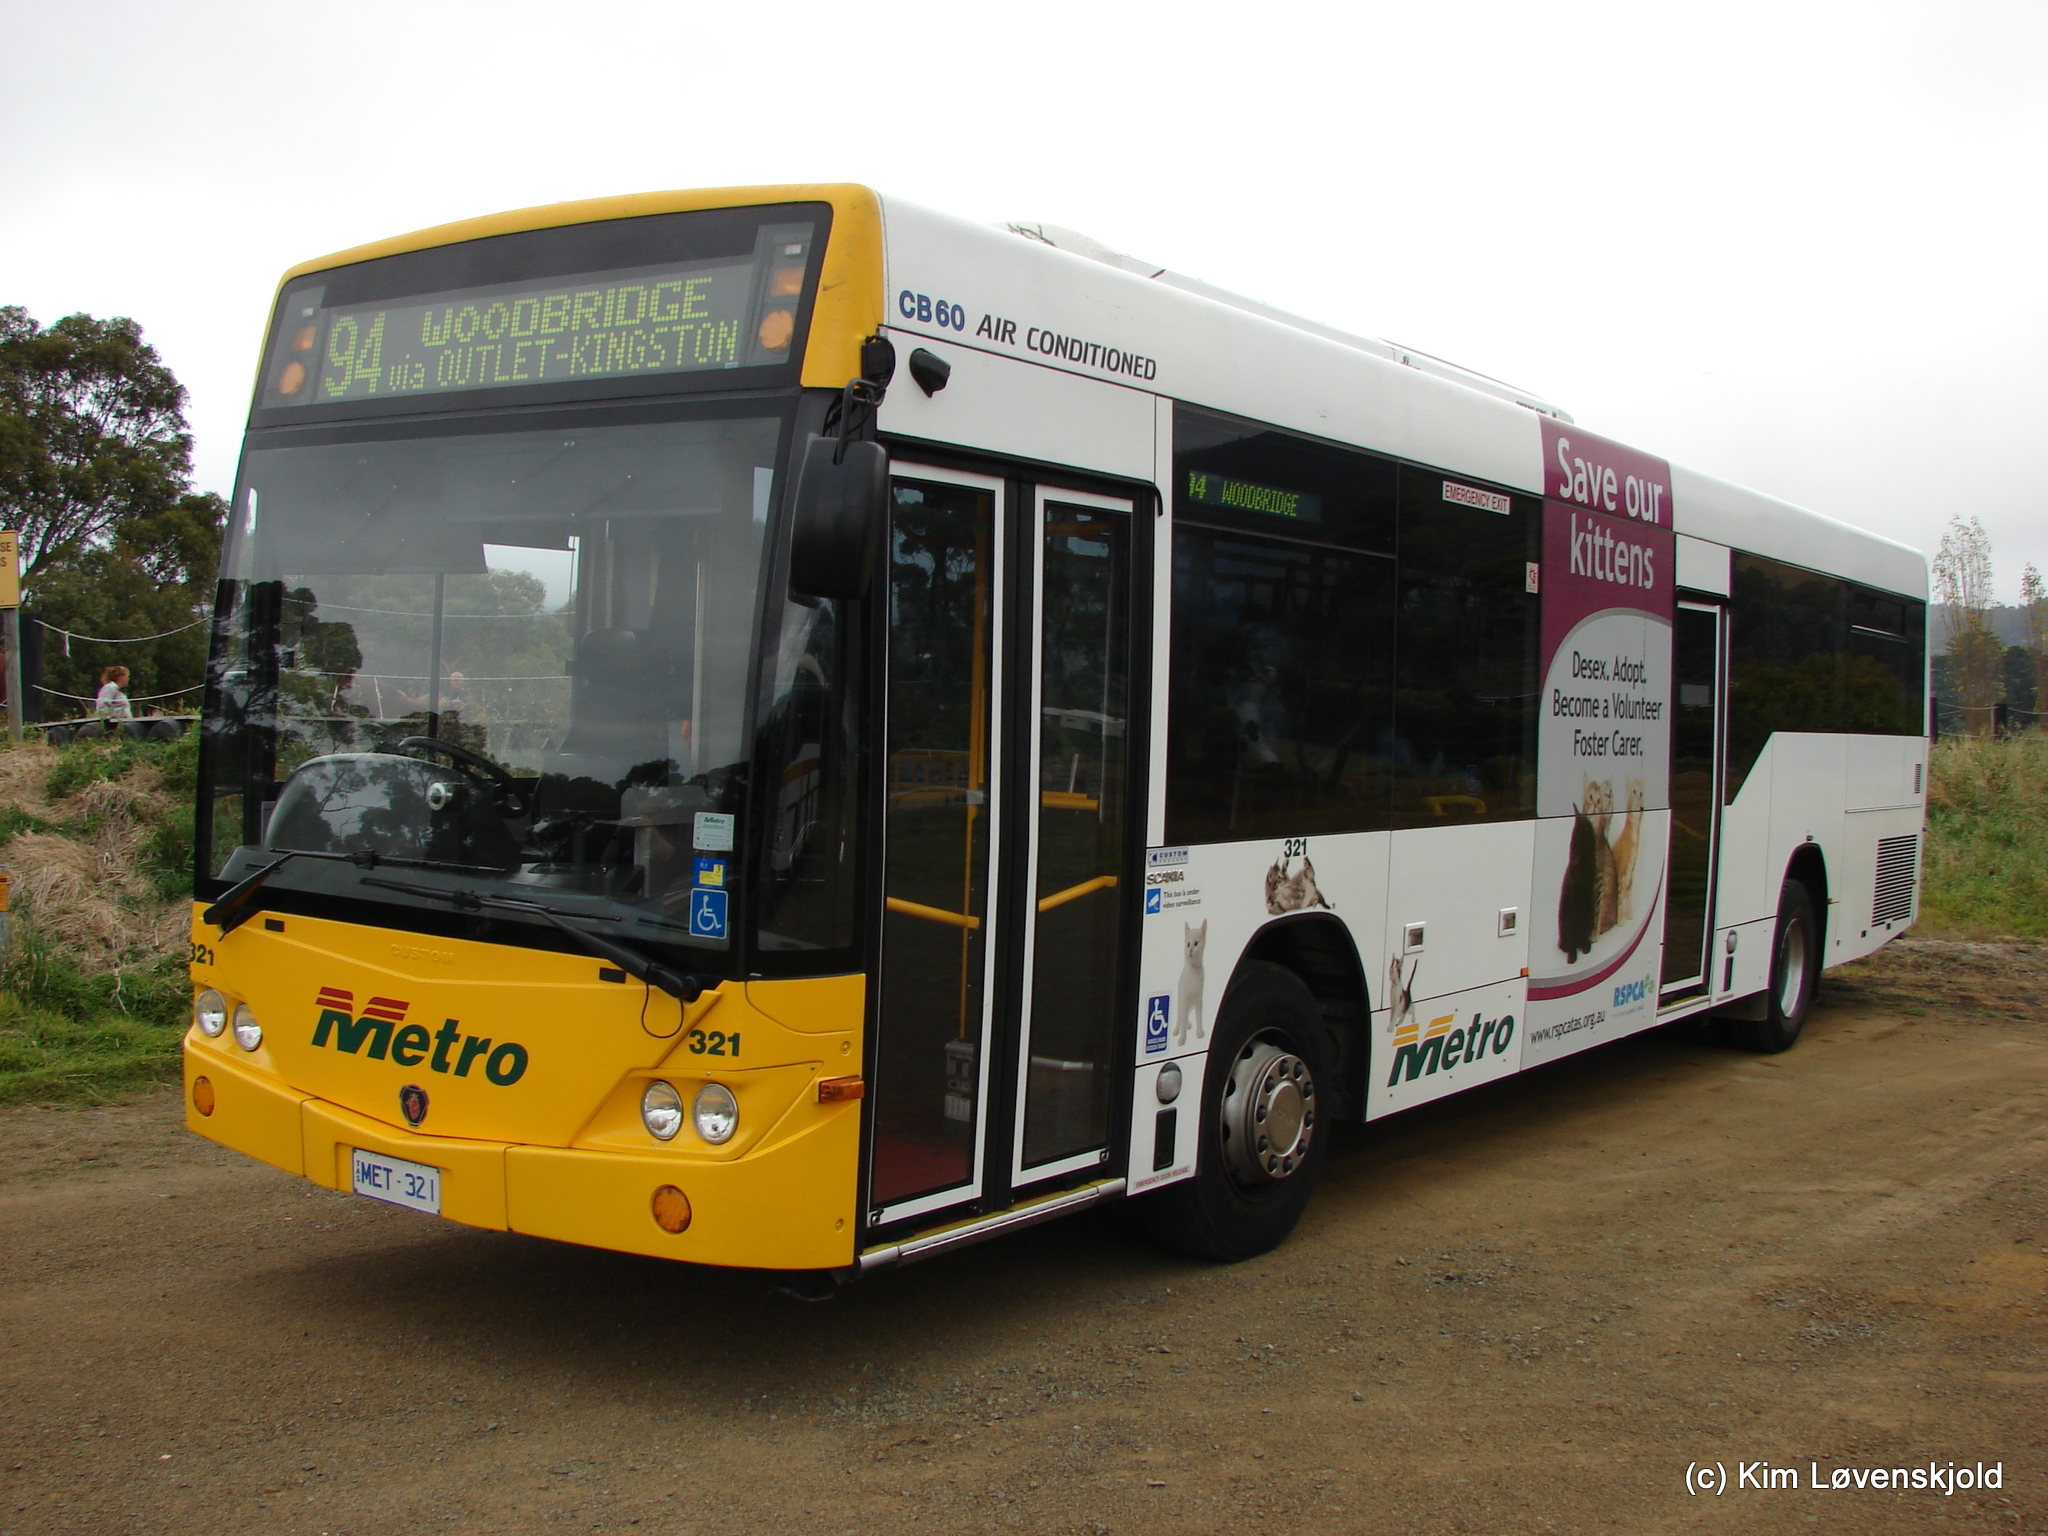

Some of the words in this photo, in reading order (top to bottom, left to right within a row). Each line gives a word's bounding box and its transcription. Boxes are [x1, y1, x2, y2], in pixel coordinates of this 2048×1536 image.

[422, 276, 713, 347] WOODBRIDGE
[325, 311, 386, 397] 94
[389, 353, 426, 391] via
[437, 319, 739, 387] OUTLET-KINGSTON
[975, 313, 1018, 346] AIR
[1026, 327, 1157, 381] CONDITIONED
[1221, 480, 1300, 517] WOODBRIDGE
[1444, 484, 1490, 508] EMERGENCY
[1491, 496, 1508, 512] EXIT
[1557, 437, 1618, 512] Save
[1625, 475, 1663, 525] our
[1569, 512, 1655, 590] kittens
[1572, 650, 1610, 682] Desex.
[1612, 655, 1647, 690] Adopt.
[1553, 688, 1600, 718] Become
[1602, 699, 1610, 719] a
[1612, 692, 1663, 721] Volunteer
[1573, 728, 1610, 757] Foster
[1612, 729, 1643, 757] Carer.
[1159, 850, 1188, 859] CUSTOM
[1284, 838, 1307, 859] 321
[1613, 979, 1645, 1007] RSPCA
[311, 985, 529, 1087] Metro
[688, 1029, 741, 1057] 321
[1530, 1010, 1606, 1045] www.rspcatas.org.au
[1387, 1013, 1515, 1088] Metro
